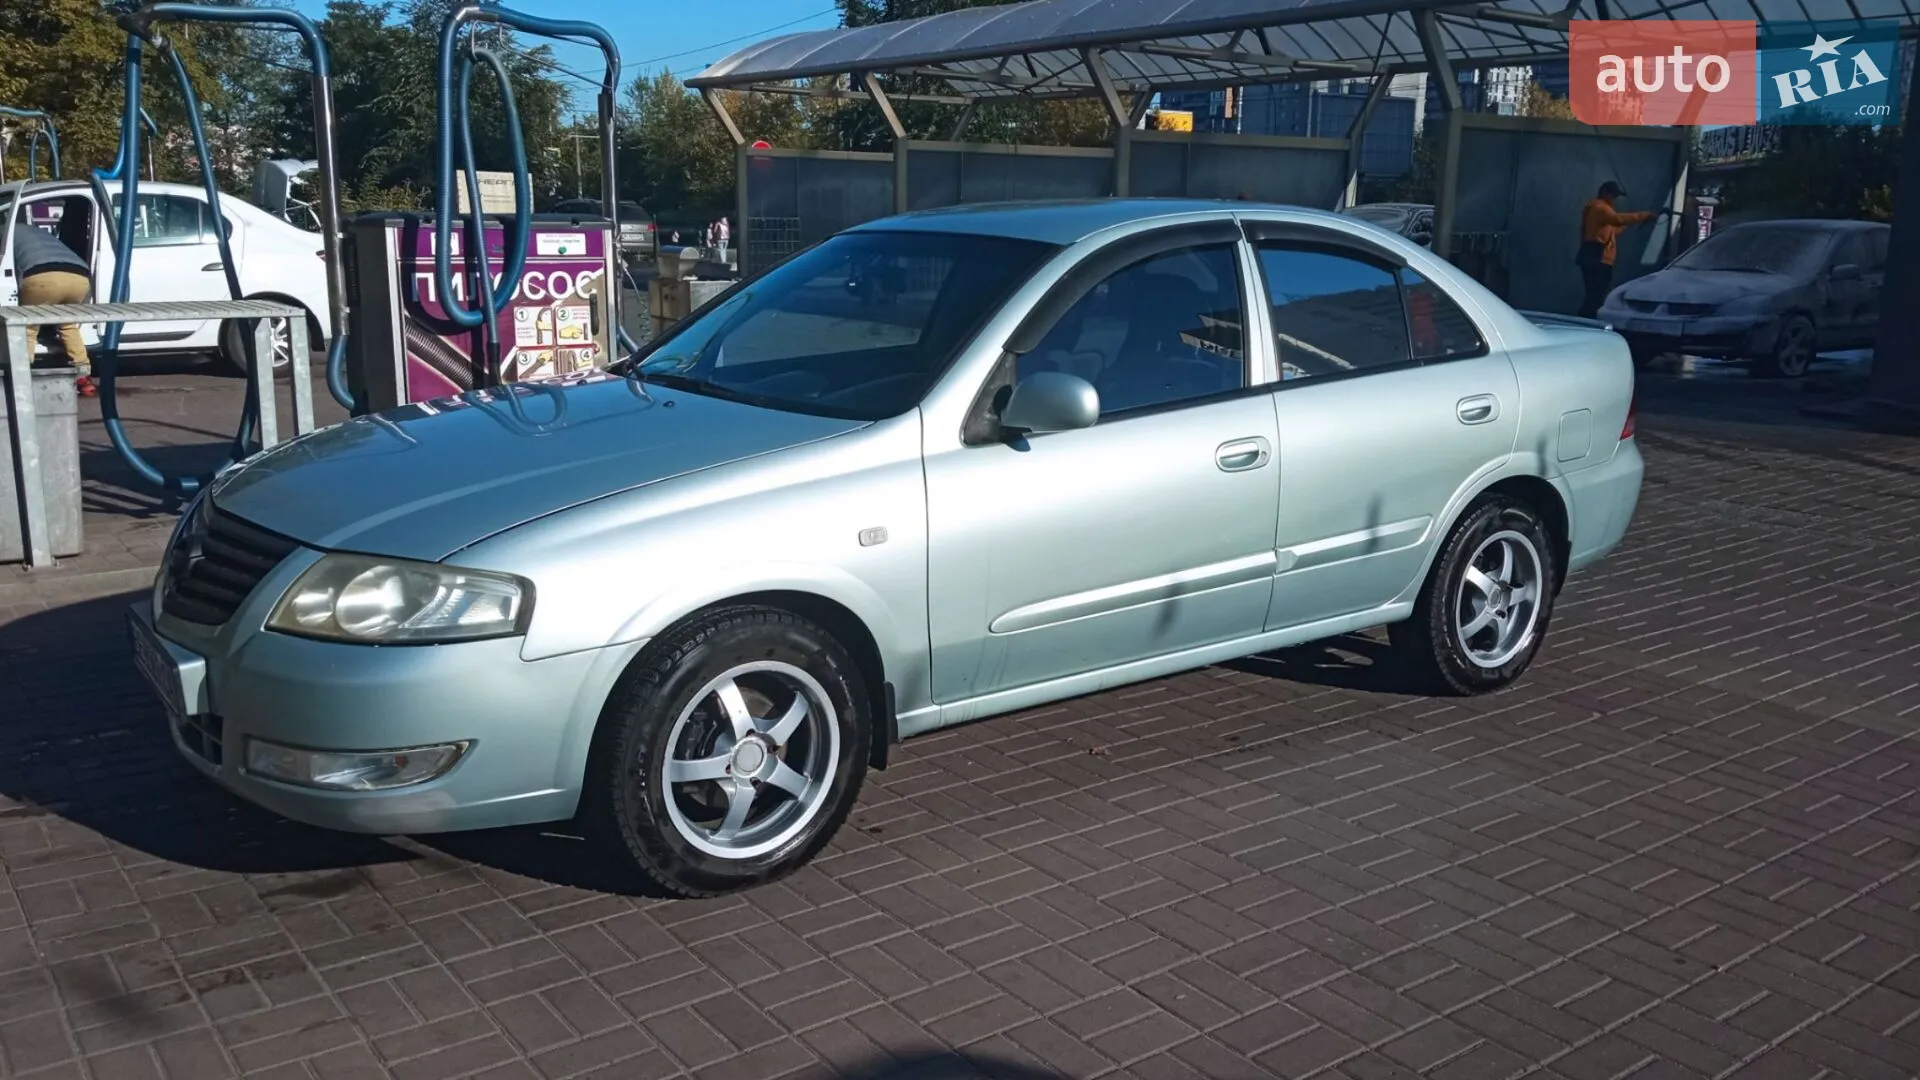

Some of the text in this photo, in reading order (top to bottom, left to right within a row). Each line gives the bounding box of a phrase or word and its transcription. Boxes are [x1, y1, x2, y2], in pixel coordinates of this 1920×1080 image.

[560, 309, 567, 318] 2
[521, 353, 528, 362] 3
[583, 351, 590, 359] 4
